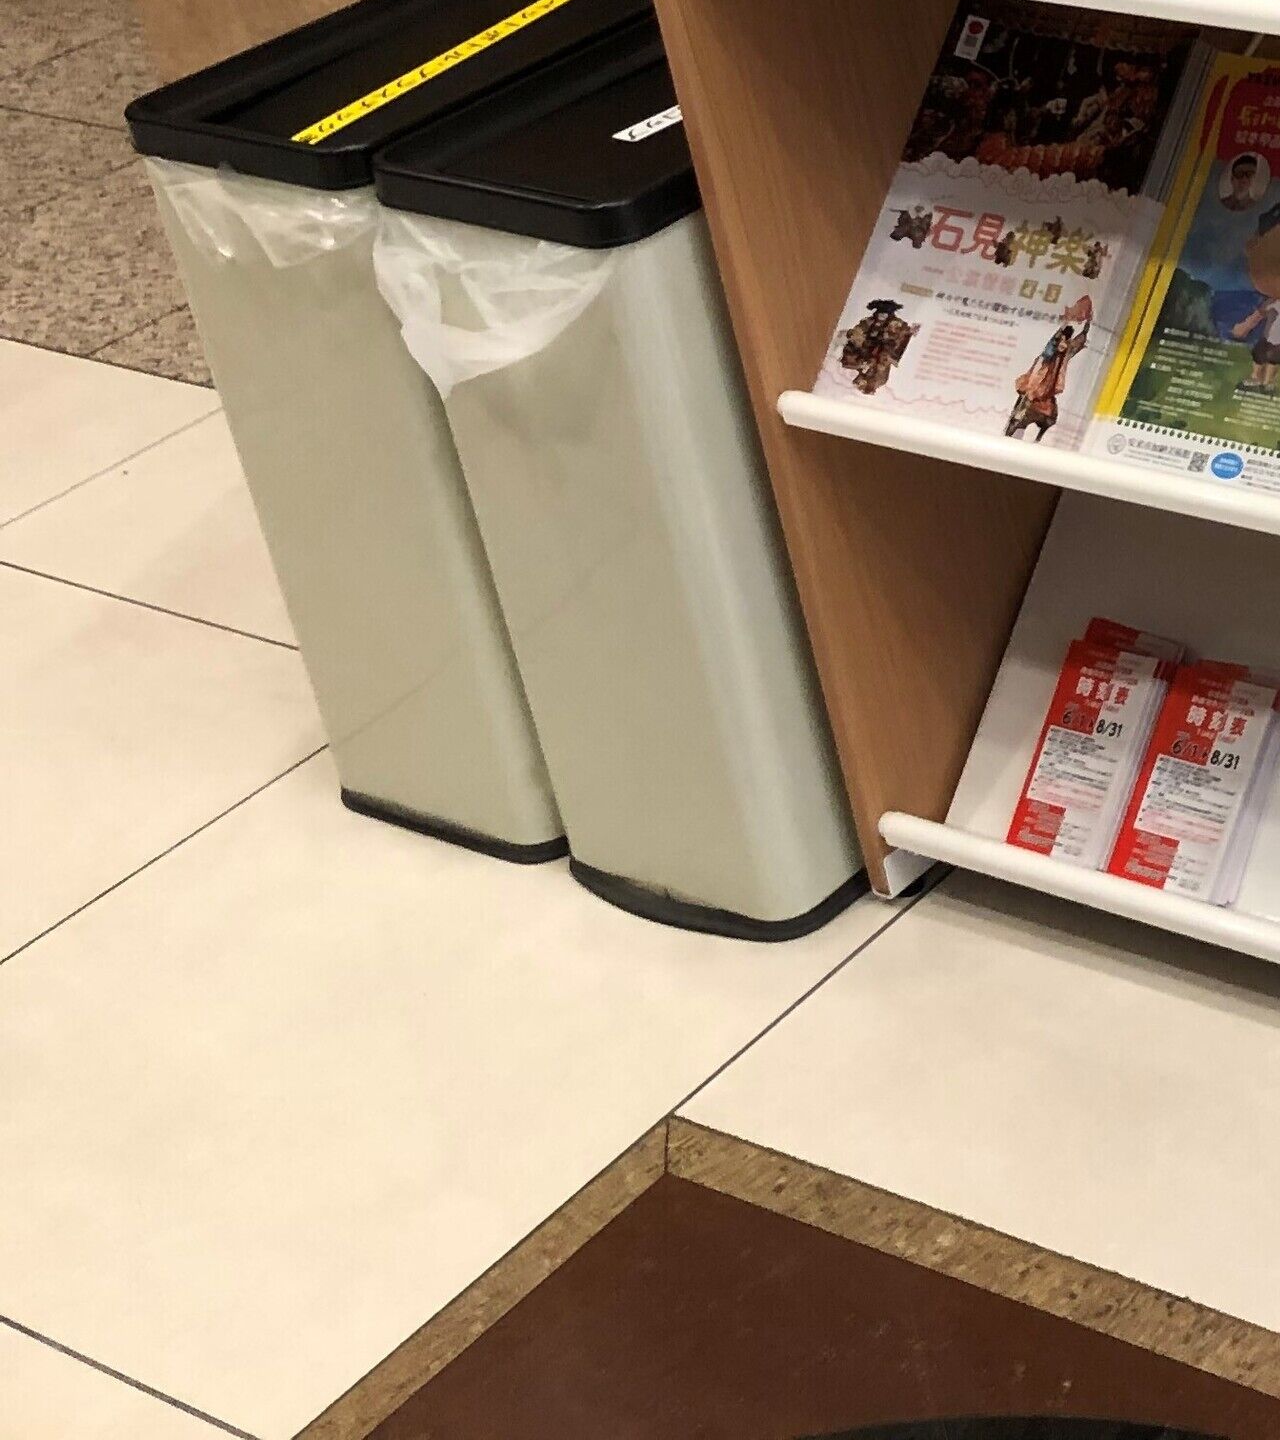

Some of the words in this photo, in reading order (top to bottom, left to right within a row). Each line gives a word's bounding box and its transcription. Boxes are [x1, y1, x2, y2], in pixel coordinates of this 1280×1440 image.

[929, 205, 1098, 276] 石見神楽
[1096, 720, 1124, 738] 8/31
[1210, 750, 1241, 770] 8/31
